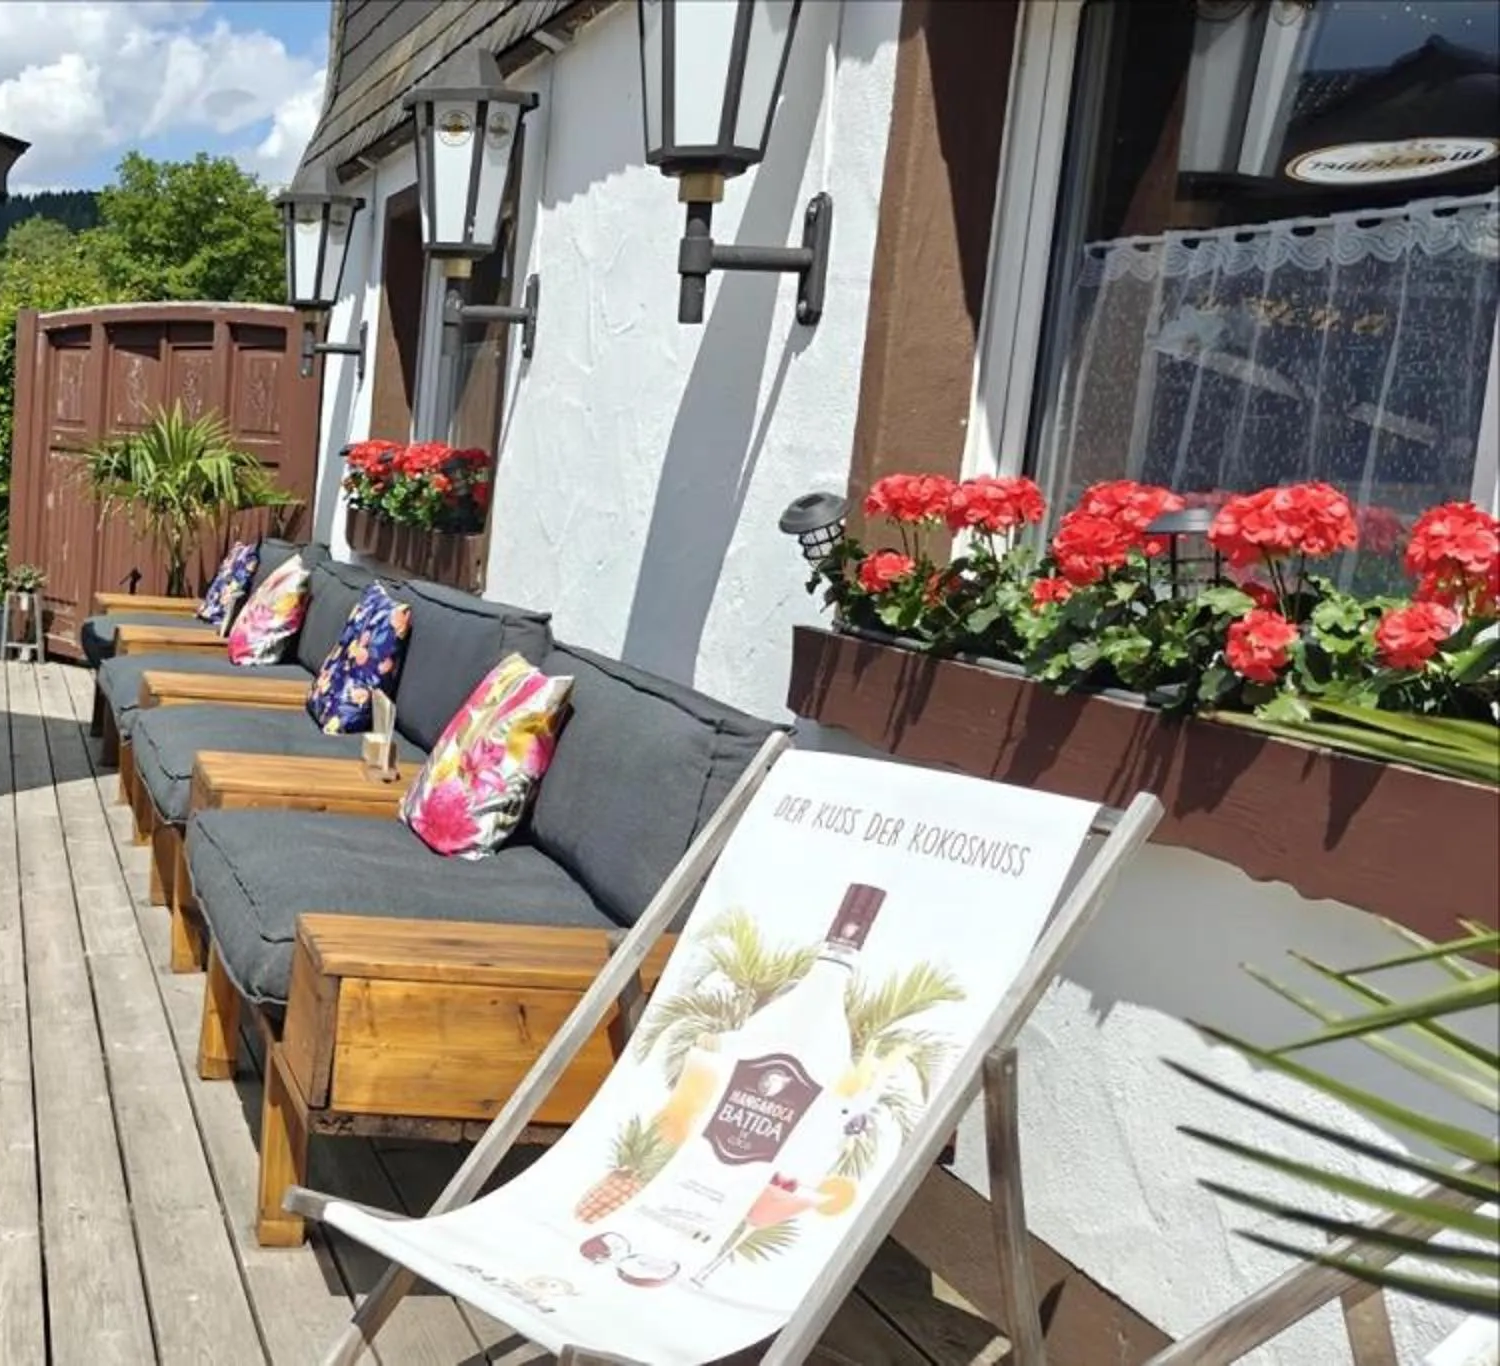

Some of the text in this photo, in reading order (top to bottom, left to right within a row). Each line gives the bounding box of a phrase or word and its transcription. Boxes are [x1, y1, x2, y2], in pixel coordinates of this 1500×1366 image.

[773, 794, 1032, 877] DER KUSS DER KOKOSNUSS
[718, 1103, 783, 1142] BATIDA
